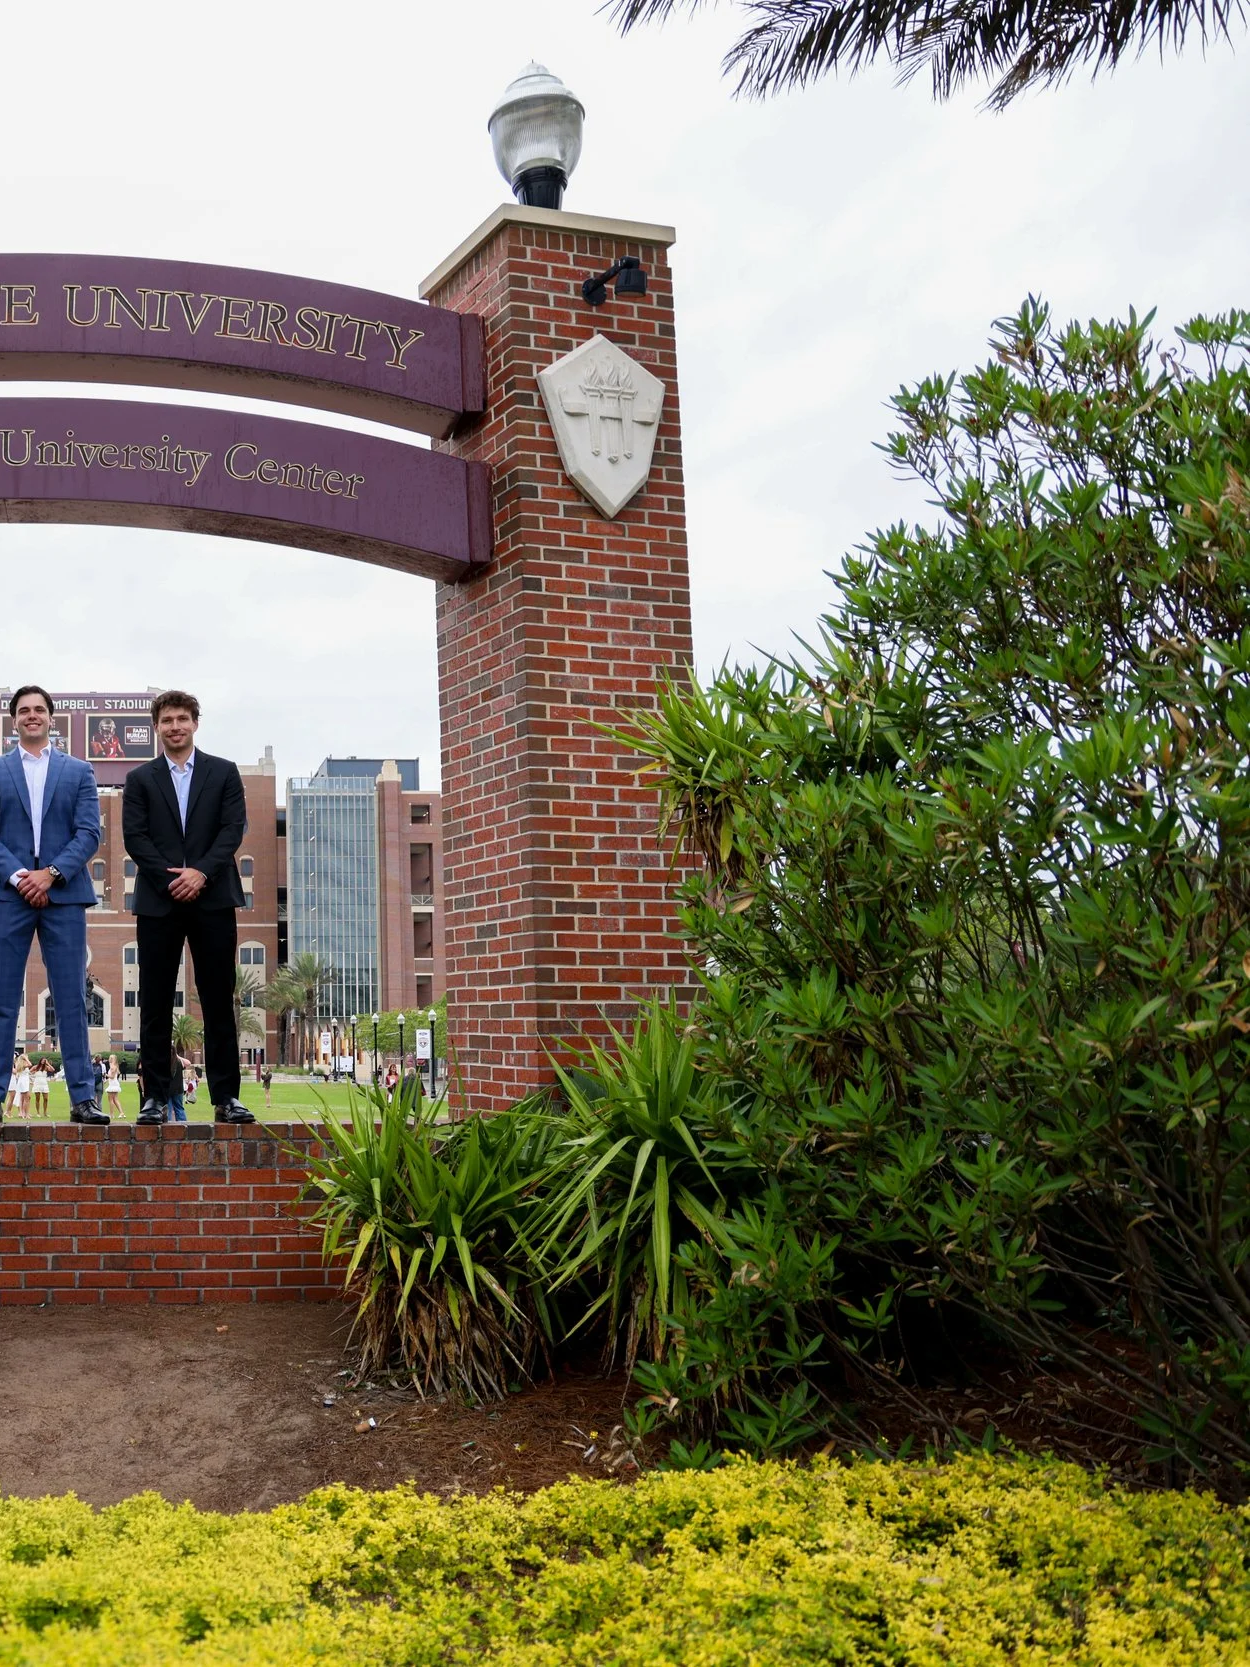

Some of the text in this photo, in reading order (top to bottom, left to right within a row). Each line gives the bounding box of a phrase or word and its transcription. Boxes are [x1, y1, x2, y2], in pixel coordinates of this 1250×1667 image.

[63, 285, 425, 370] UNIVERSITY
[224, 443, 365, 500] Center
[53, 699, 99, 709] MPBELL
